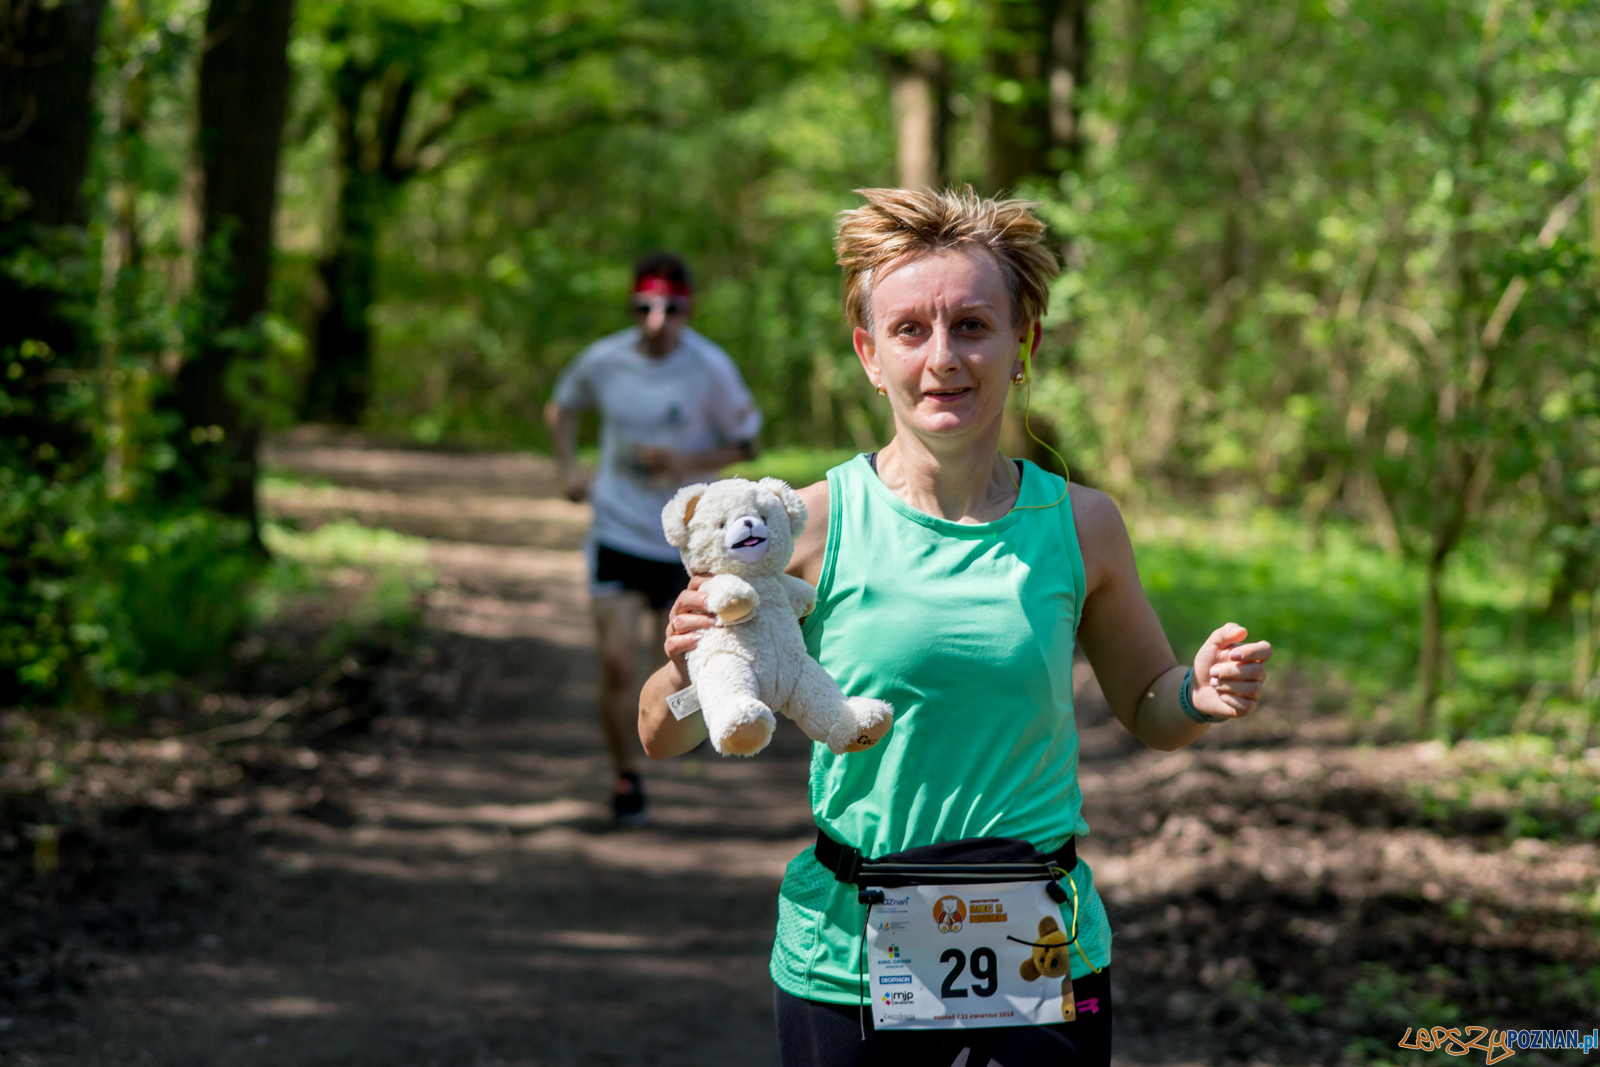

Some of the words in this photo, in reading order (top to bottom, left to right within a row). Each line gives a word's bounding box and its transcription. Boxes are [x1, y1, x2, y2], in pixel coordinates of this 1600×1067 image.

[969, 904, 993, 914] BIEG
[969, 913, 1007, 923] MISIEM
[939, 947, 998, 999] 29
[893, 990, 914, 1001] mjp
